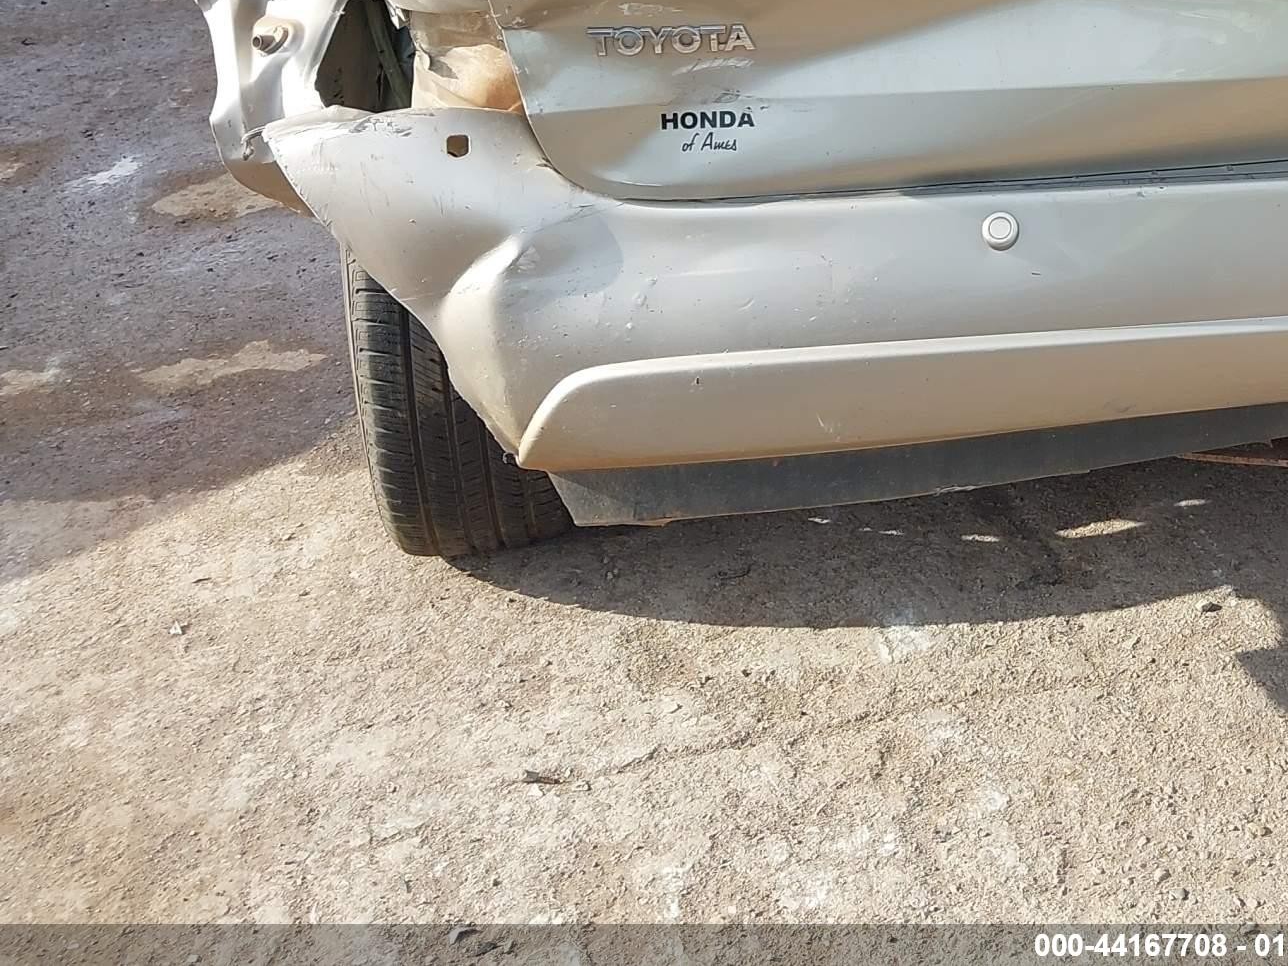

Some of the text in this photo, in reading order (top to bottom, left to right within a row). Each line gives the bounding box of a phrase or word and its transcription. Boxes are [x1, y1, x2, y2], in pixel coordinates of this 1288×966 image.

[586, 23, 756, 56] TOYOTA
[660, 109, 755, 130] HONDA
[681, 132, 738, 152] of Ames
